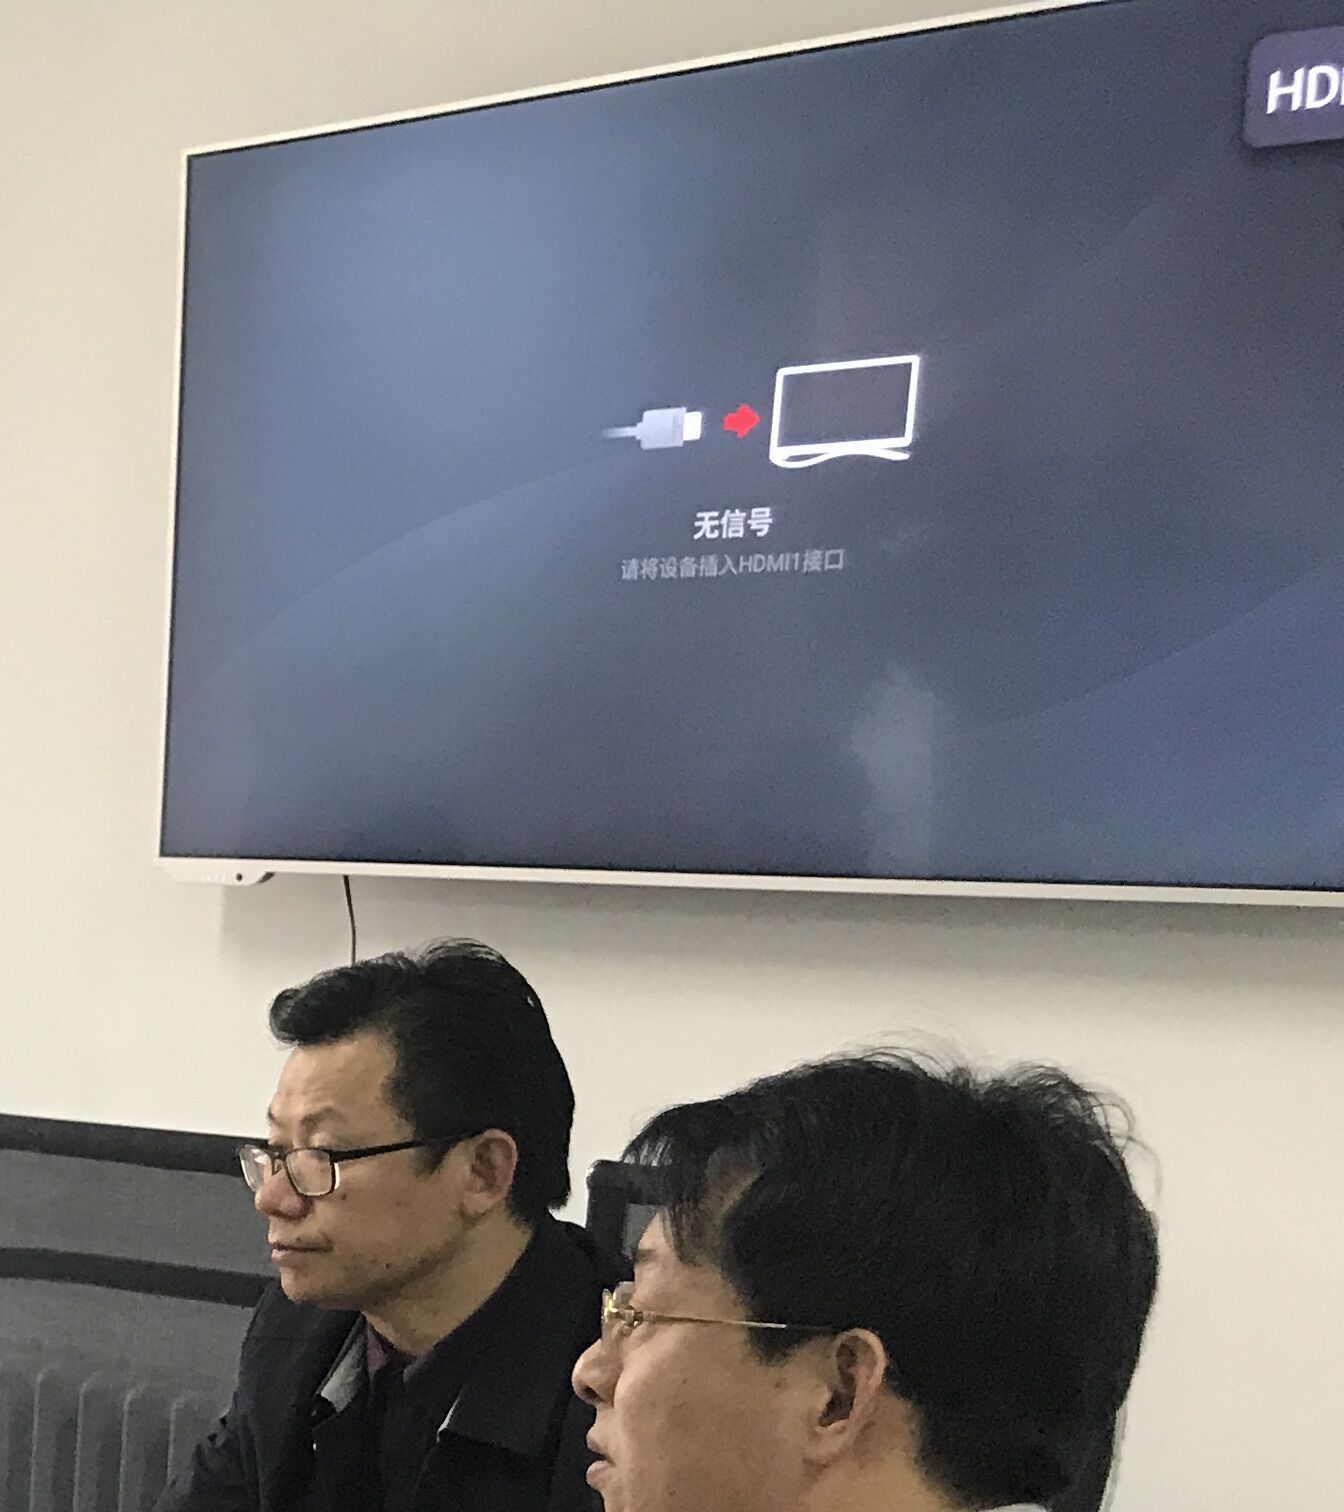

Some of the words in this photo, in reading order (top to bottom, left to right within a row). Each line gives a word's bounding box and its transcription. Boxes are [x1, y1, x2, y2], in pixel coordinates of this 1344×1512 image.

[1266, 64, 1344, 114] HD
[692, 507, 773, 540] 无信号
[621, 549, 845, 580] 请将设备插入HDMI1接口
